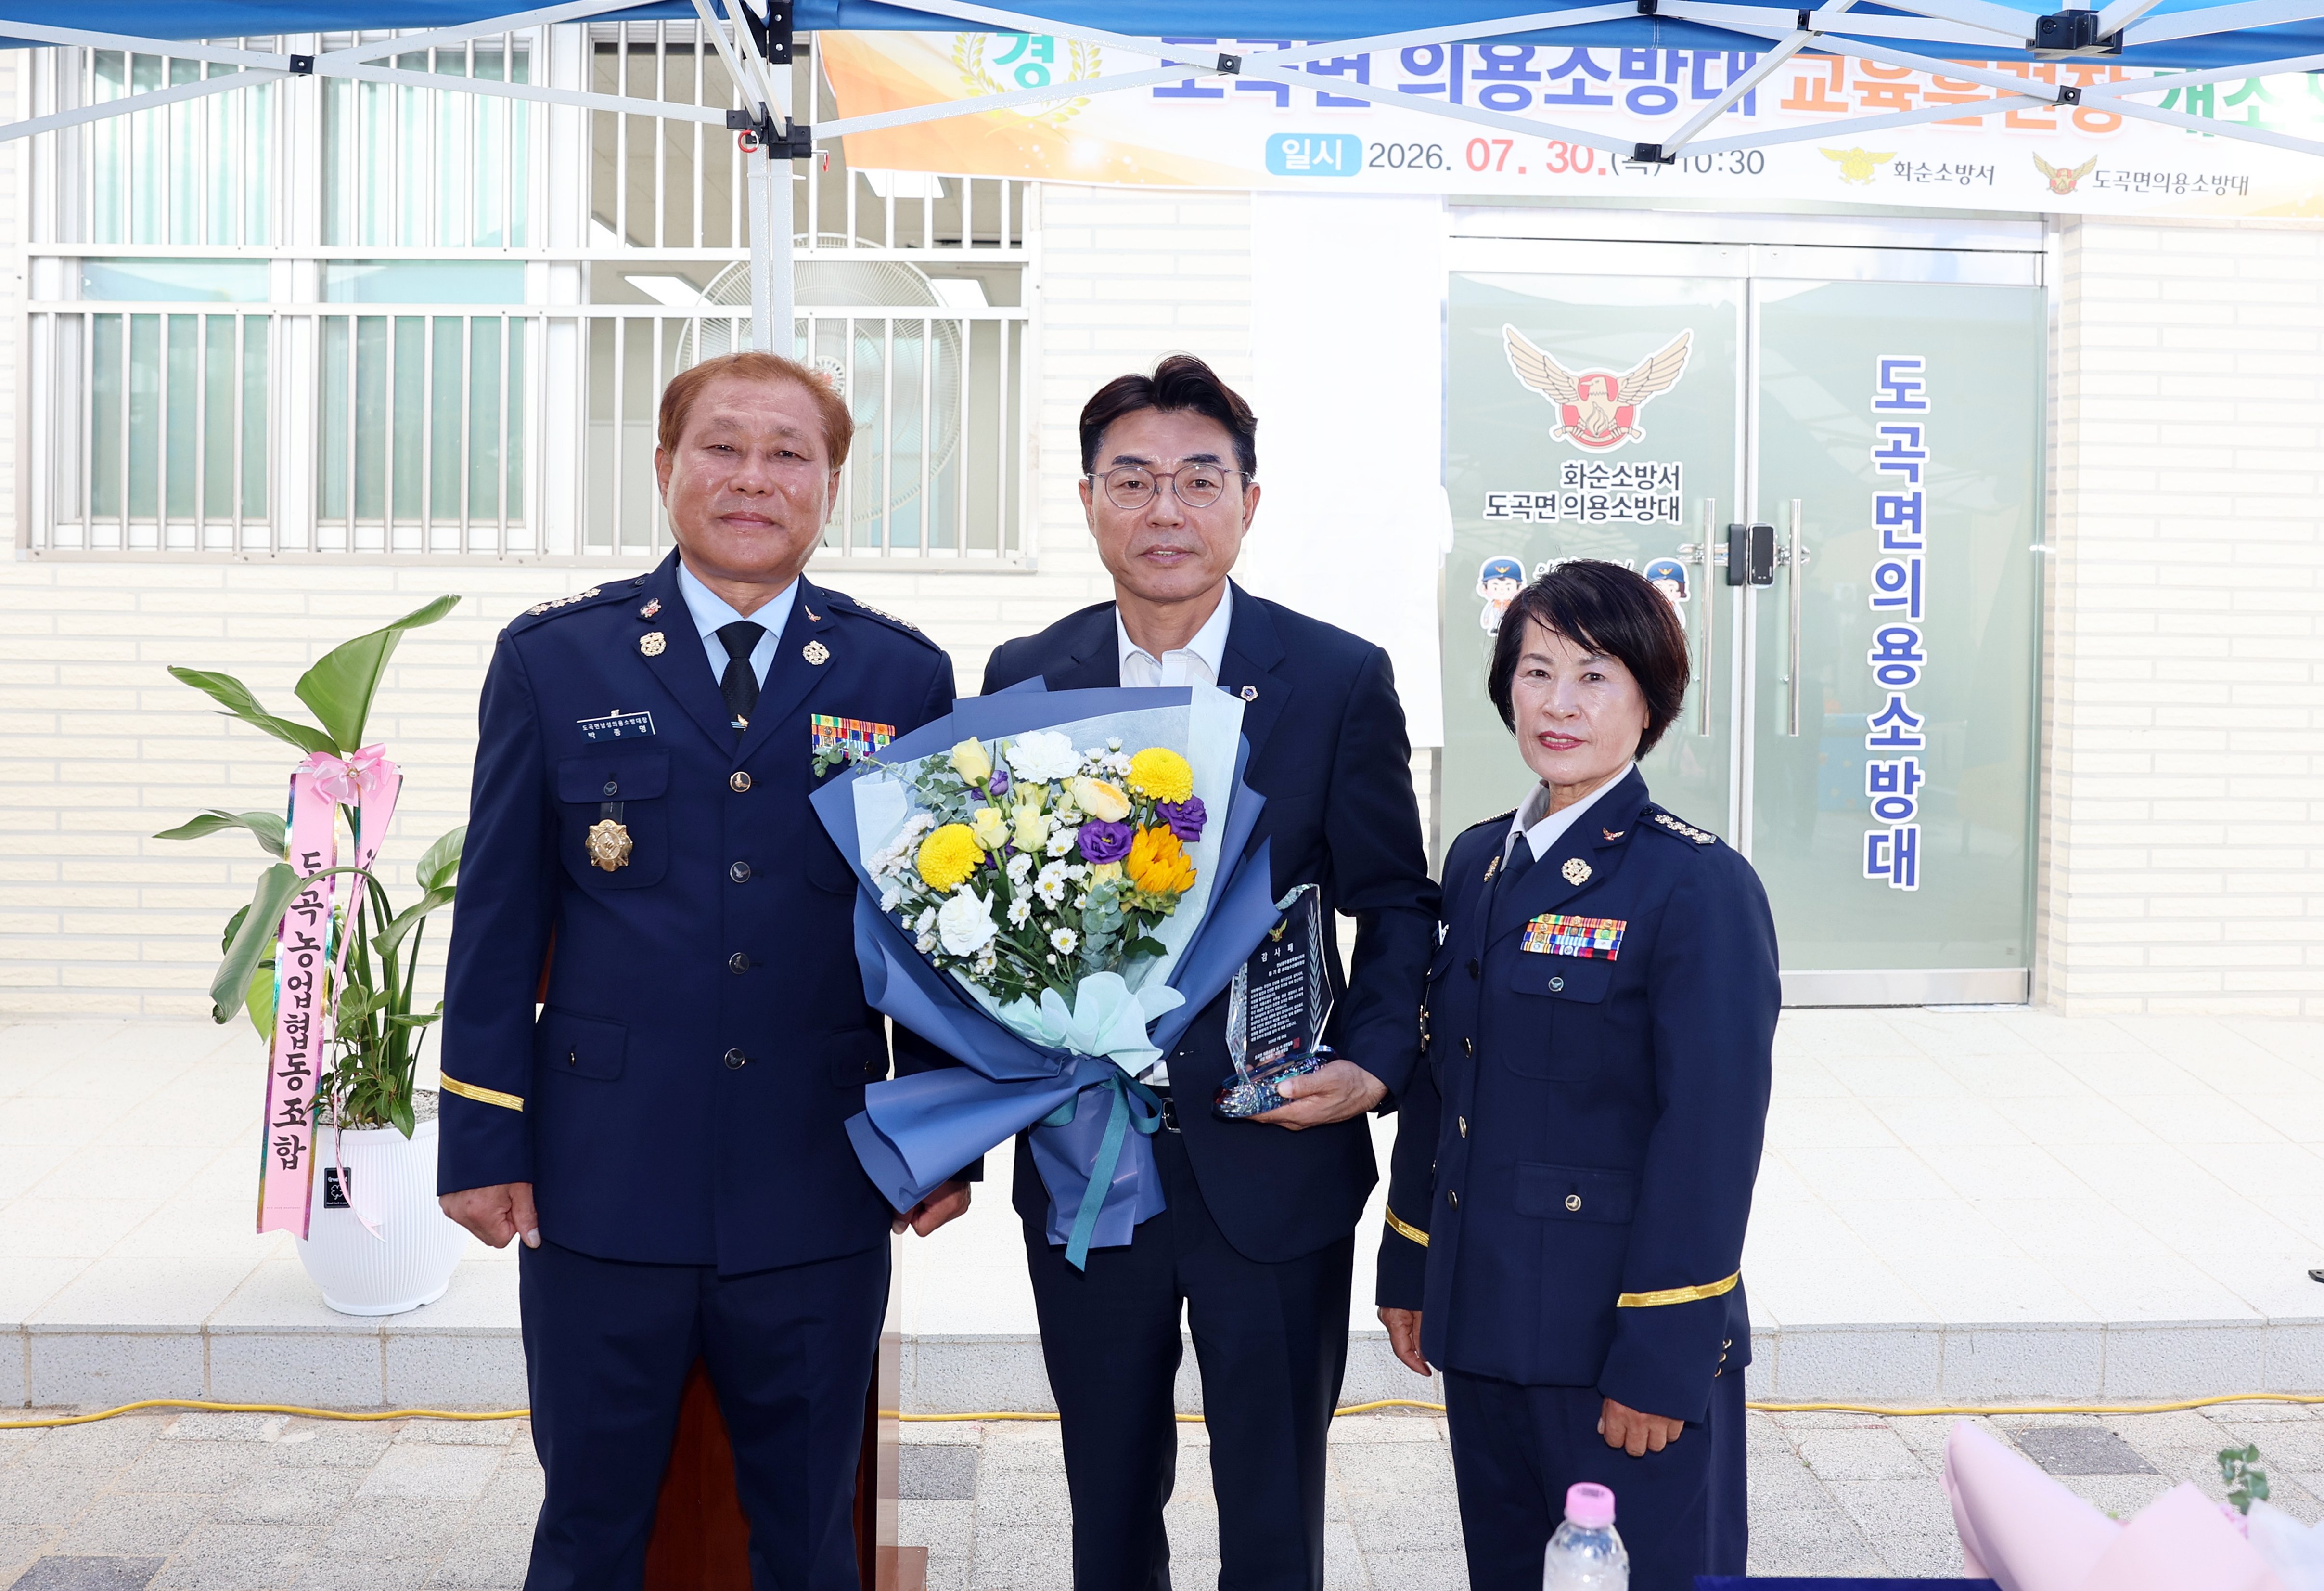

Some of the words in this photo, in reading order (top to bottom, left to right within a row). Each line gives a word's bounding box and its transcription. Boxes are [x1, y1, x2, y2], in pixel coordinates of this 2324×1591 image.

[992, 32, 1054, 89] 경
[1397, 43, 1758, 116] 의용소방대
[1281, 138, 1343, 171] 일시
[1368, 142, 1451, 171] 2026.
[1465, 138, 1527, 175] 07.
[1683, 149, 1765, 175] 10:30
[1894, 160, 1995, 186] 화순소방서
[2092, 170, 2249, 196] 도곡면의용소방대
[1563, 463, 1680, 491] 화순소방서
[1486, 493, 1556, 520] 도곡면
[1564, 493, 1680, 522] 의용소방대
[1866, 358, 1928, 888] 도곡면의용소방대
[272, 851, 326, 1171] 도곡농업협동조합
